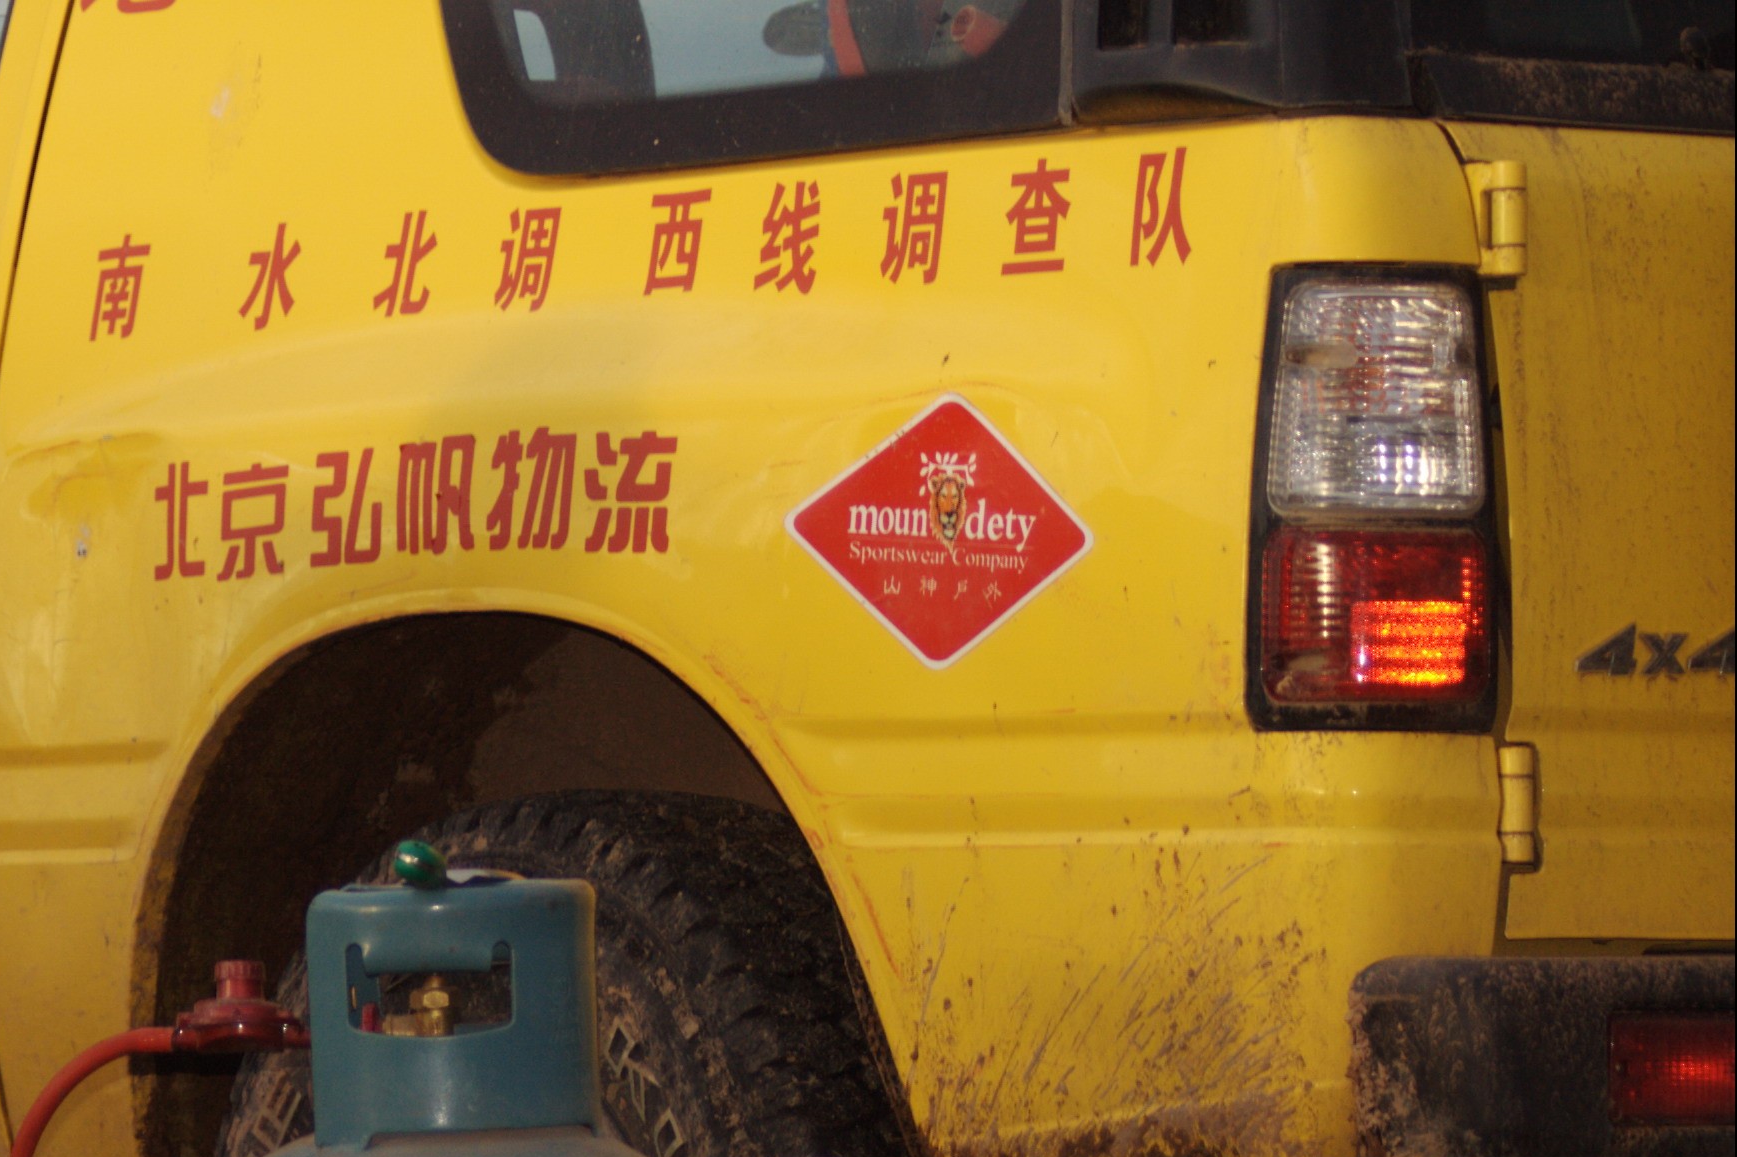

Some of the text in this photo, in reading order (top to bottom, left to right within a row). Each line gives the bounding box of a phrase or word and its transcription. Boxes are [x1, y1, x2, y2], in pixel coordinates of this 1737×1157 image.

[154, 426, 678, 582] 北京弘帆物流
[849, 541, 1029, 574] Sportswear Company
